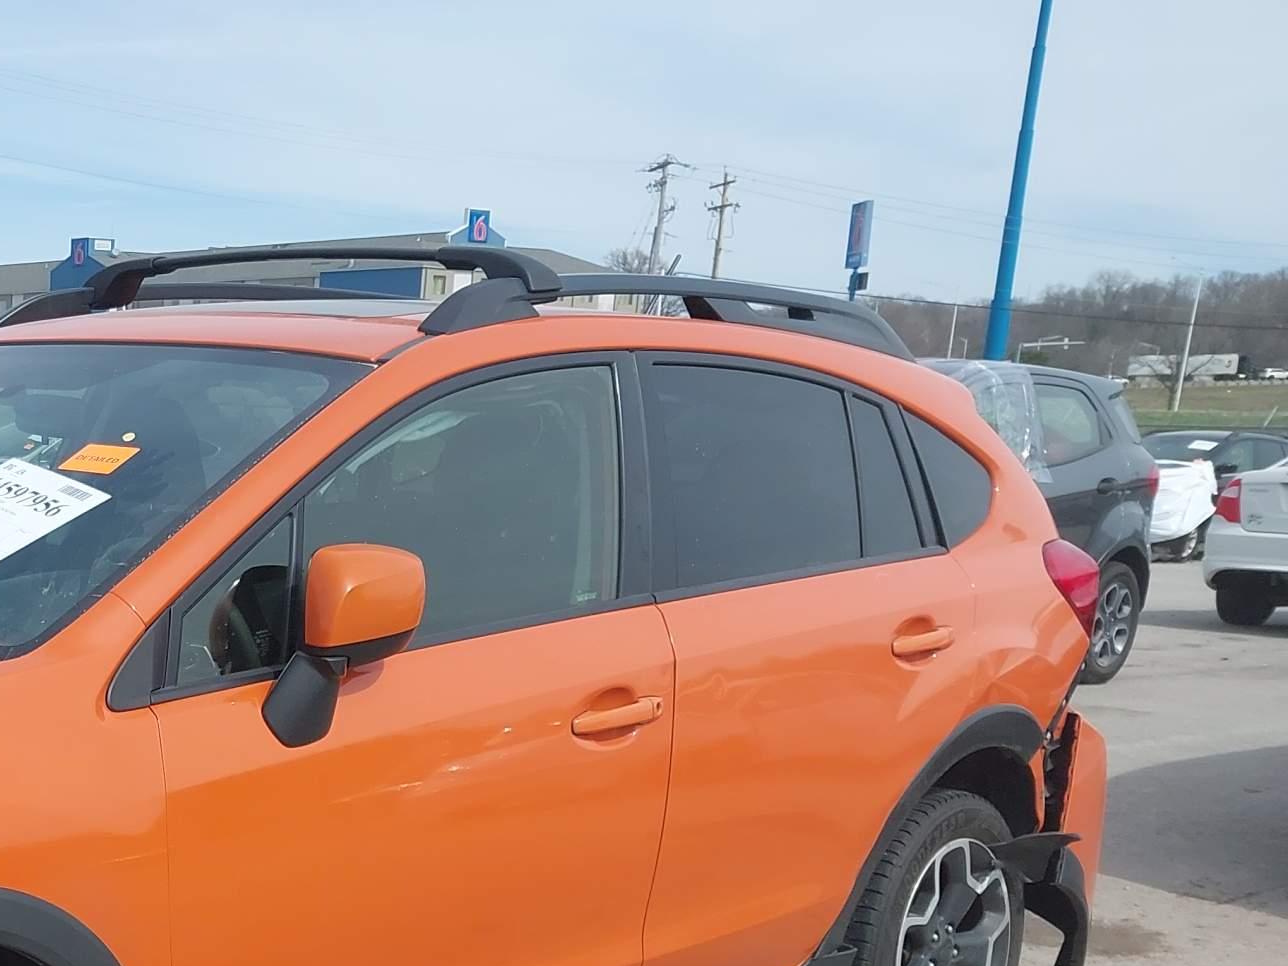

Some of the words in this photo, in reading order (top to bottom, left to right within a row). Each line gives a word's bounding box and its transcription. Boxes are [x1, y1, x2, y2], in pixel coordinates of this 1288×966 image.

[474, 215, 487, 241] 6
[74, 242, 84, 265] 6
[76, 454, 120, 464] DETAILED
